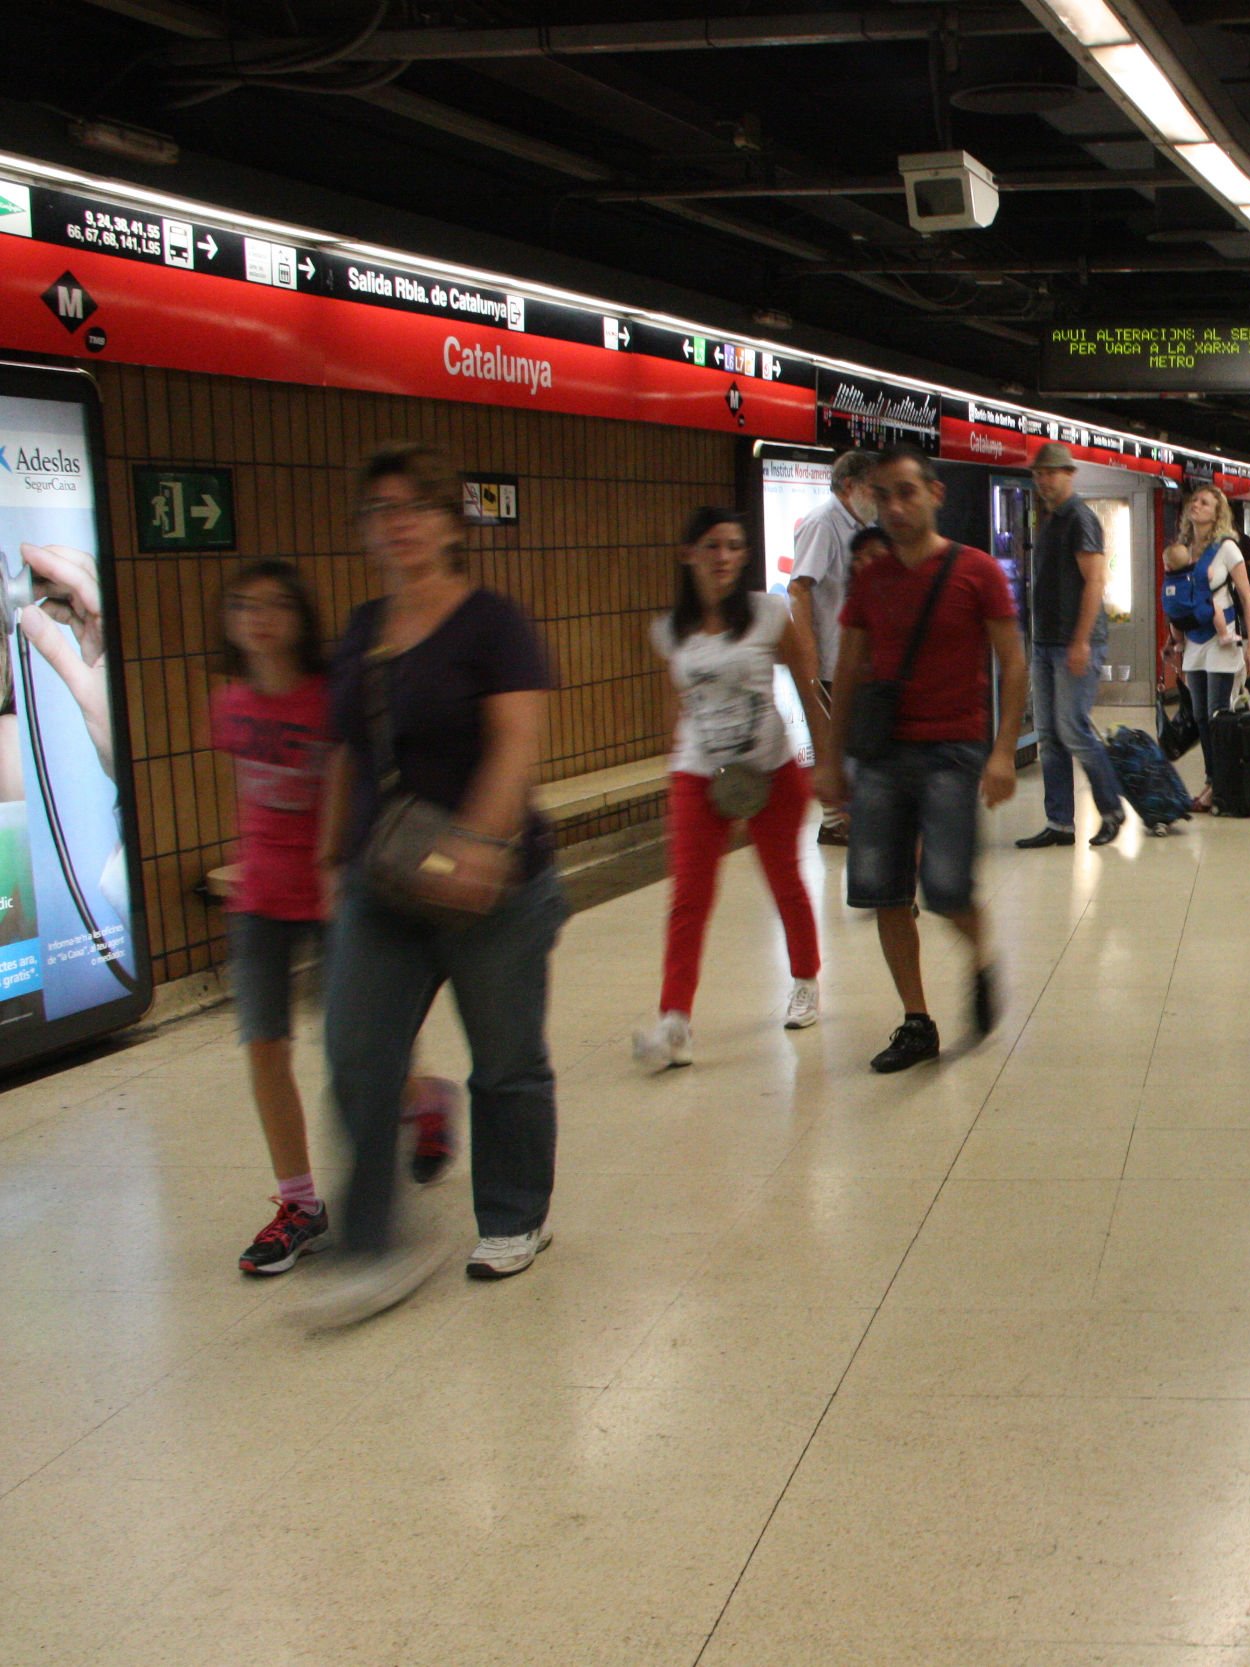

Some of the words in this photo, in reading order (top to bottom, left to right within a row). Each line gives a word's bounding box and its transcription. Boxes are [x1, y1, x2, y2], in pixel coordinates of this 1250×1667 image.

[84, 210, 97, 228] 9,
[96, 212, 114, 231] 24,
[113, 216, 131, 235] 38,
[130, 220, 147, 238] 41,
[146, 224, 160, 239] 55
[67, 223, 84, 242] 66,
[84, 228, 102, 246] 67,
[102, 230, 119, 249] 68,
[120, 234, 141, 254] 141,
[141, 238, 161, 255] L95
[57, 286, 84, 319] M
[348, 267, 393, 297] Salida
[395, 276, 429, 304] Rbla.
[430, 285, 447, 307] de
[449, 288, 508, 322] Catalunya
[1052, 328, 1087, 341] AVUI
[1203, 328, 1222, 341] AL
[1069, 342, 1097, 355] PER
[1105, 342, 1141, 355] VAGA
[1149, 342, 1159, 354] A
[1167, 342, 1186, 354] LA
[1194, 341, 1240, 354] XARXA
[443, 335, 552, 395] Catalunya
[724, 354, 734, 370] L6
[735, 355, 745, 372] L7
[1149, 354, 1195, 368] METRO
[16, 447, 81, 474] Adeslas
[770, 461, 794, 478] Institut
[24, 476, 77, 493] SegurCaixa
